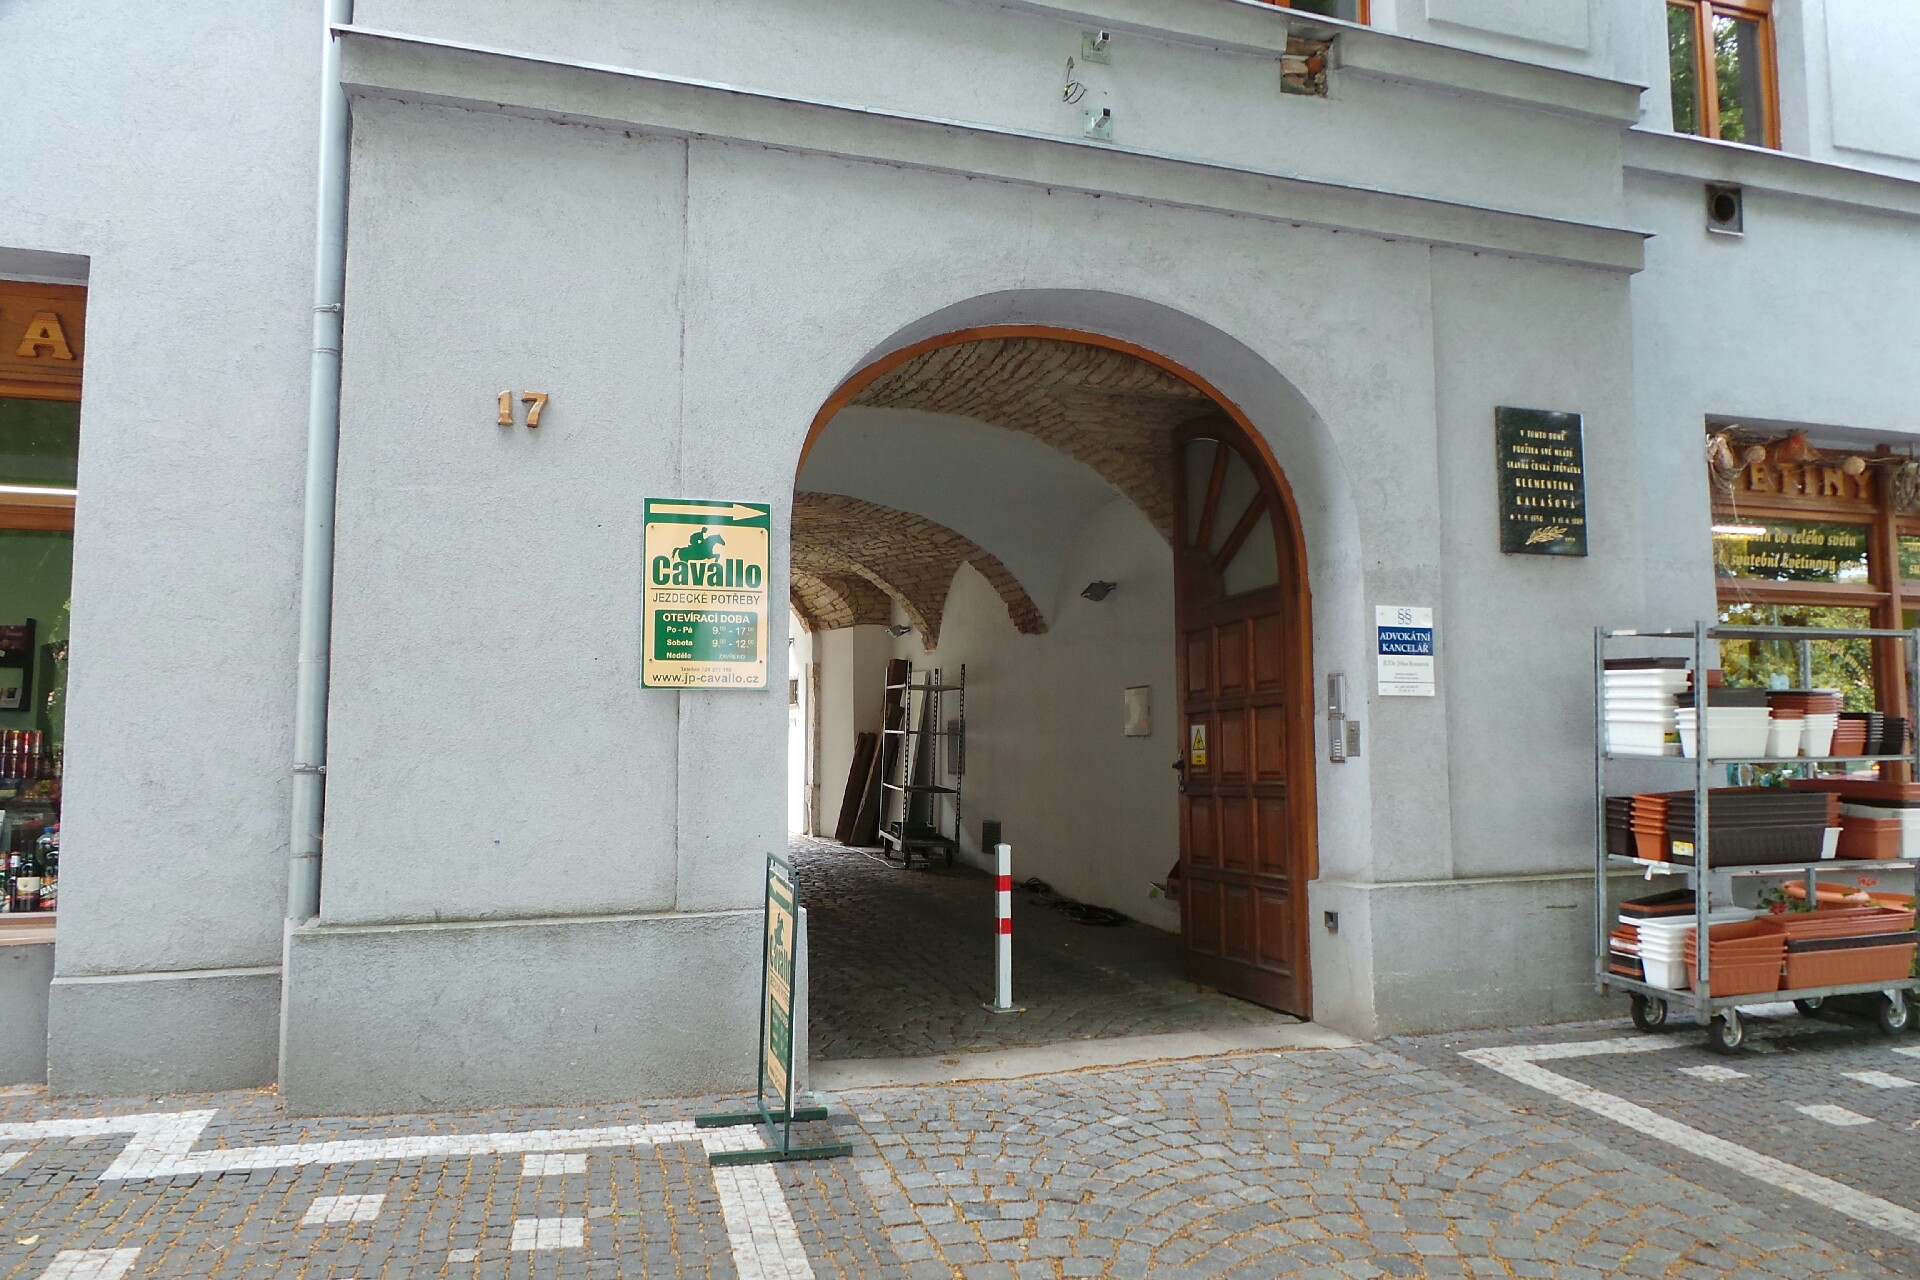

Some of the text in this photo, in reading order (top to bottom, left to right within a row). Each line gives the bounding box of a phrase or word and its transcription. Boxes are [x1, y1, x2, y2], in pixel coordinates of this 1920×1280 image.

[497, 389, 549, 429] 17
[652, 555, 762, 588] Cavallo
[652, 592, 761, 605] JEZDECKÉ POTŘEBY
[662, 612, 750, 624] OTEVÍRACÍ DOBA
[666, 626, 677, 634] Po
[682, 626, 693, 634] Pá
[666, 638, 693, 647] Sobota
[1379, 631, 1431, 642] ADVOKÁTNÍ
[1382, 642, 1429, 653] KANCELÁŘ
[652, 672, 759, 685] www.jp-cavallo.cz
